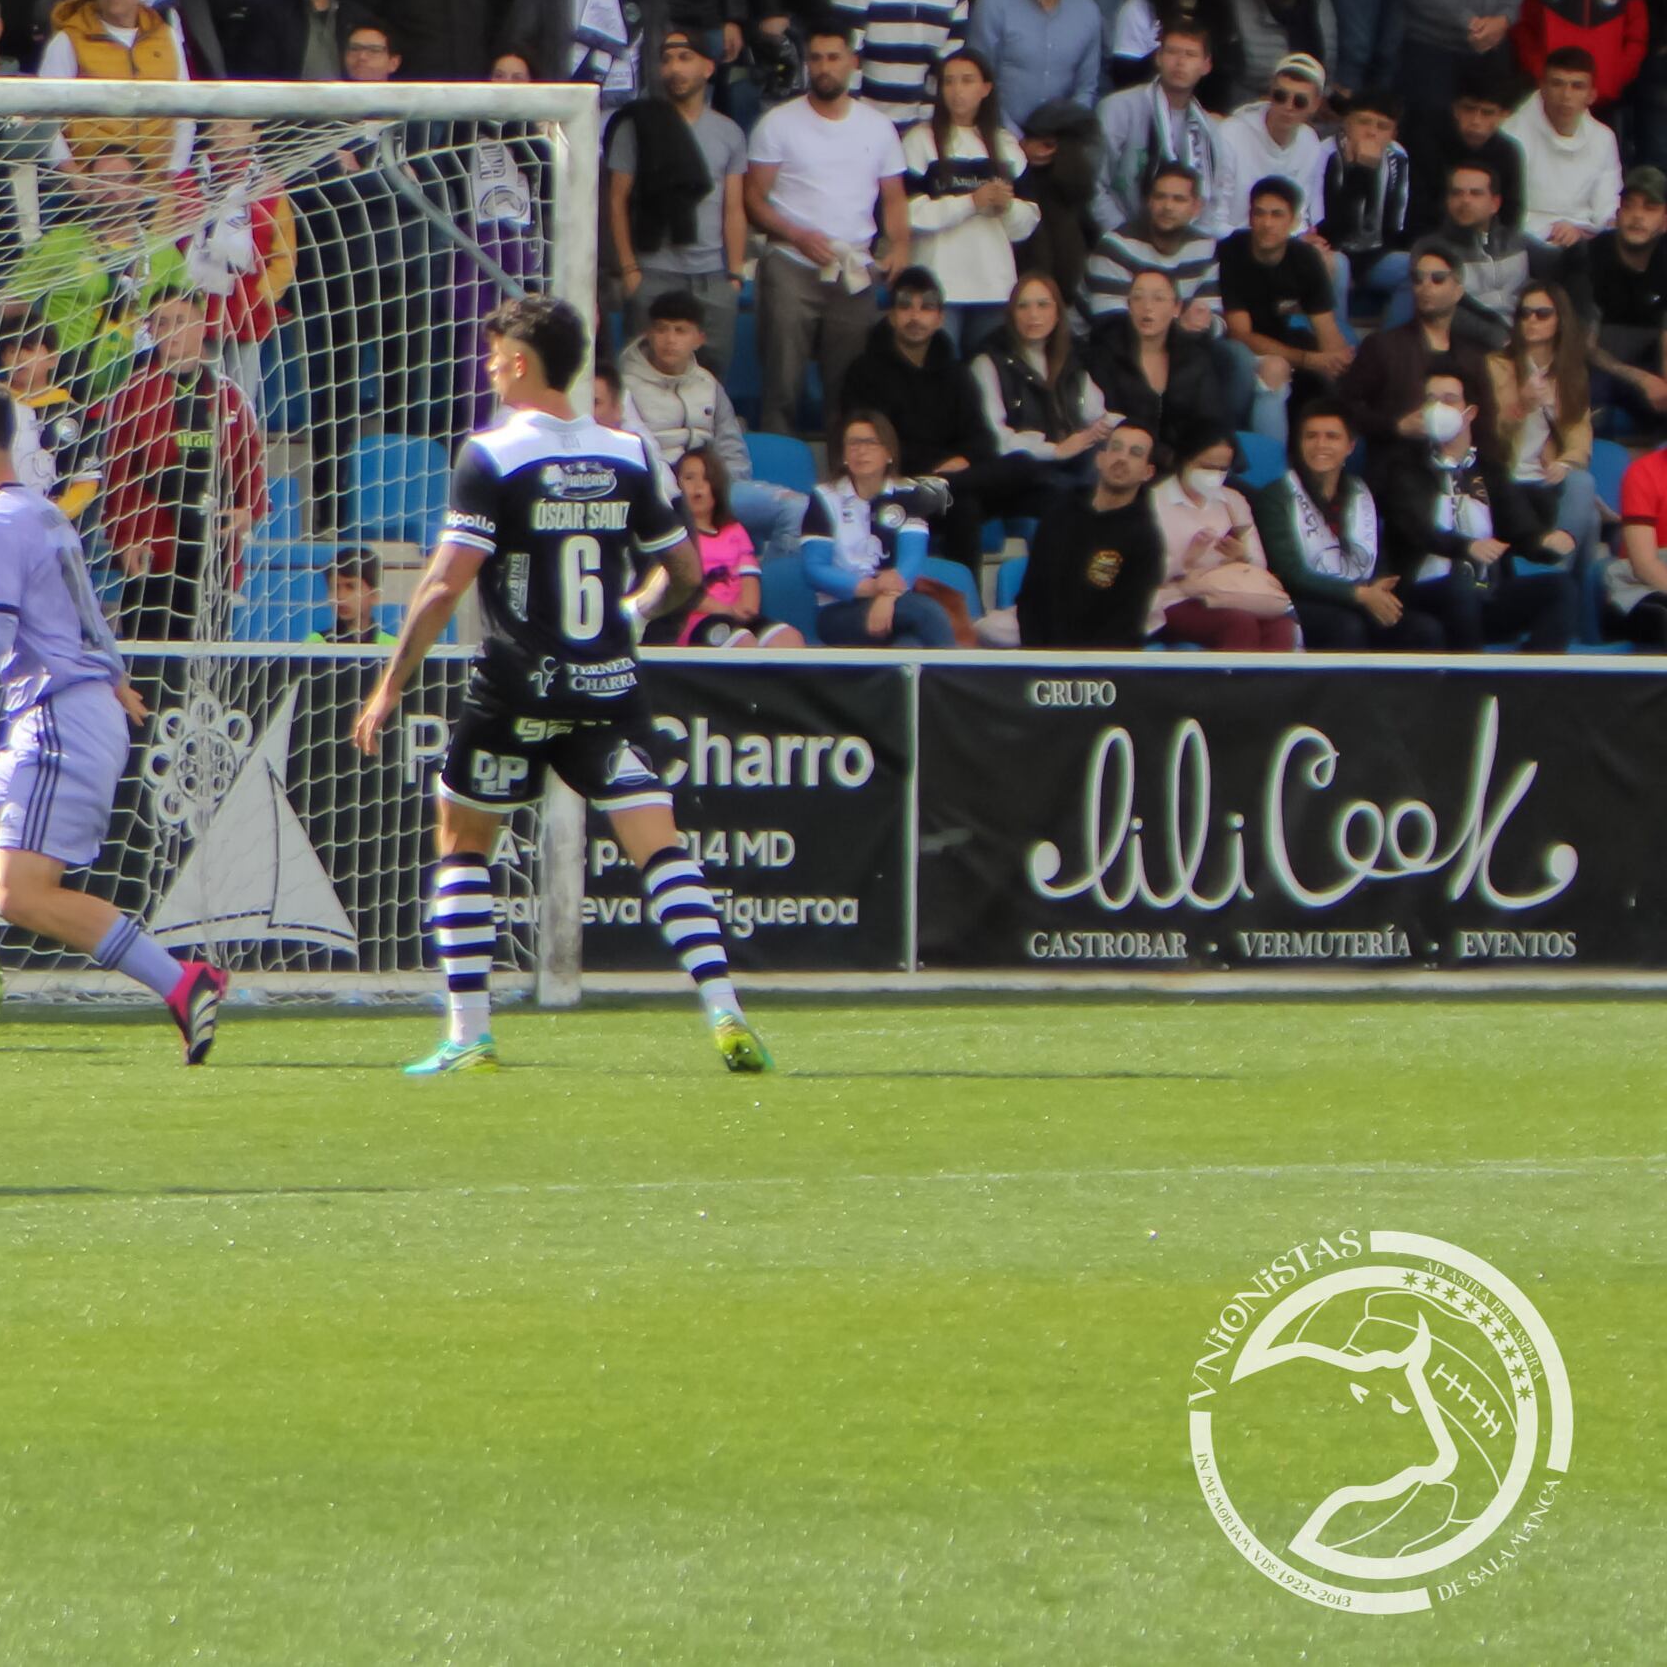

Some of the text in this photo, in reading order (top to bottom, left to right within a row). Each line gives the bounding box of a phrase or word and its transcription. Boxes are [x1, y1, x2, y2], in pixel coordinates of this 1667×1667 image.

[561, 535, 603, 641] 6
[1031, 680, 1118, 707] GRUPO
[1029, 924, 1578, 960] GASTROBAR VERMUTERÍA EVENTOS
